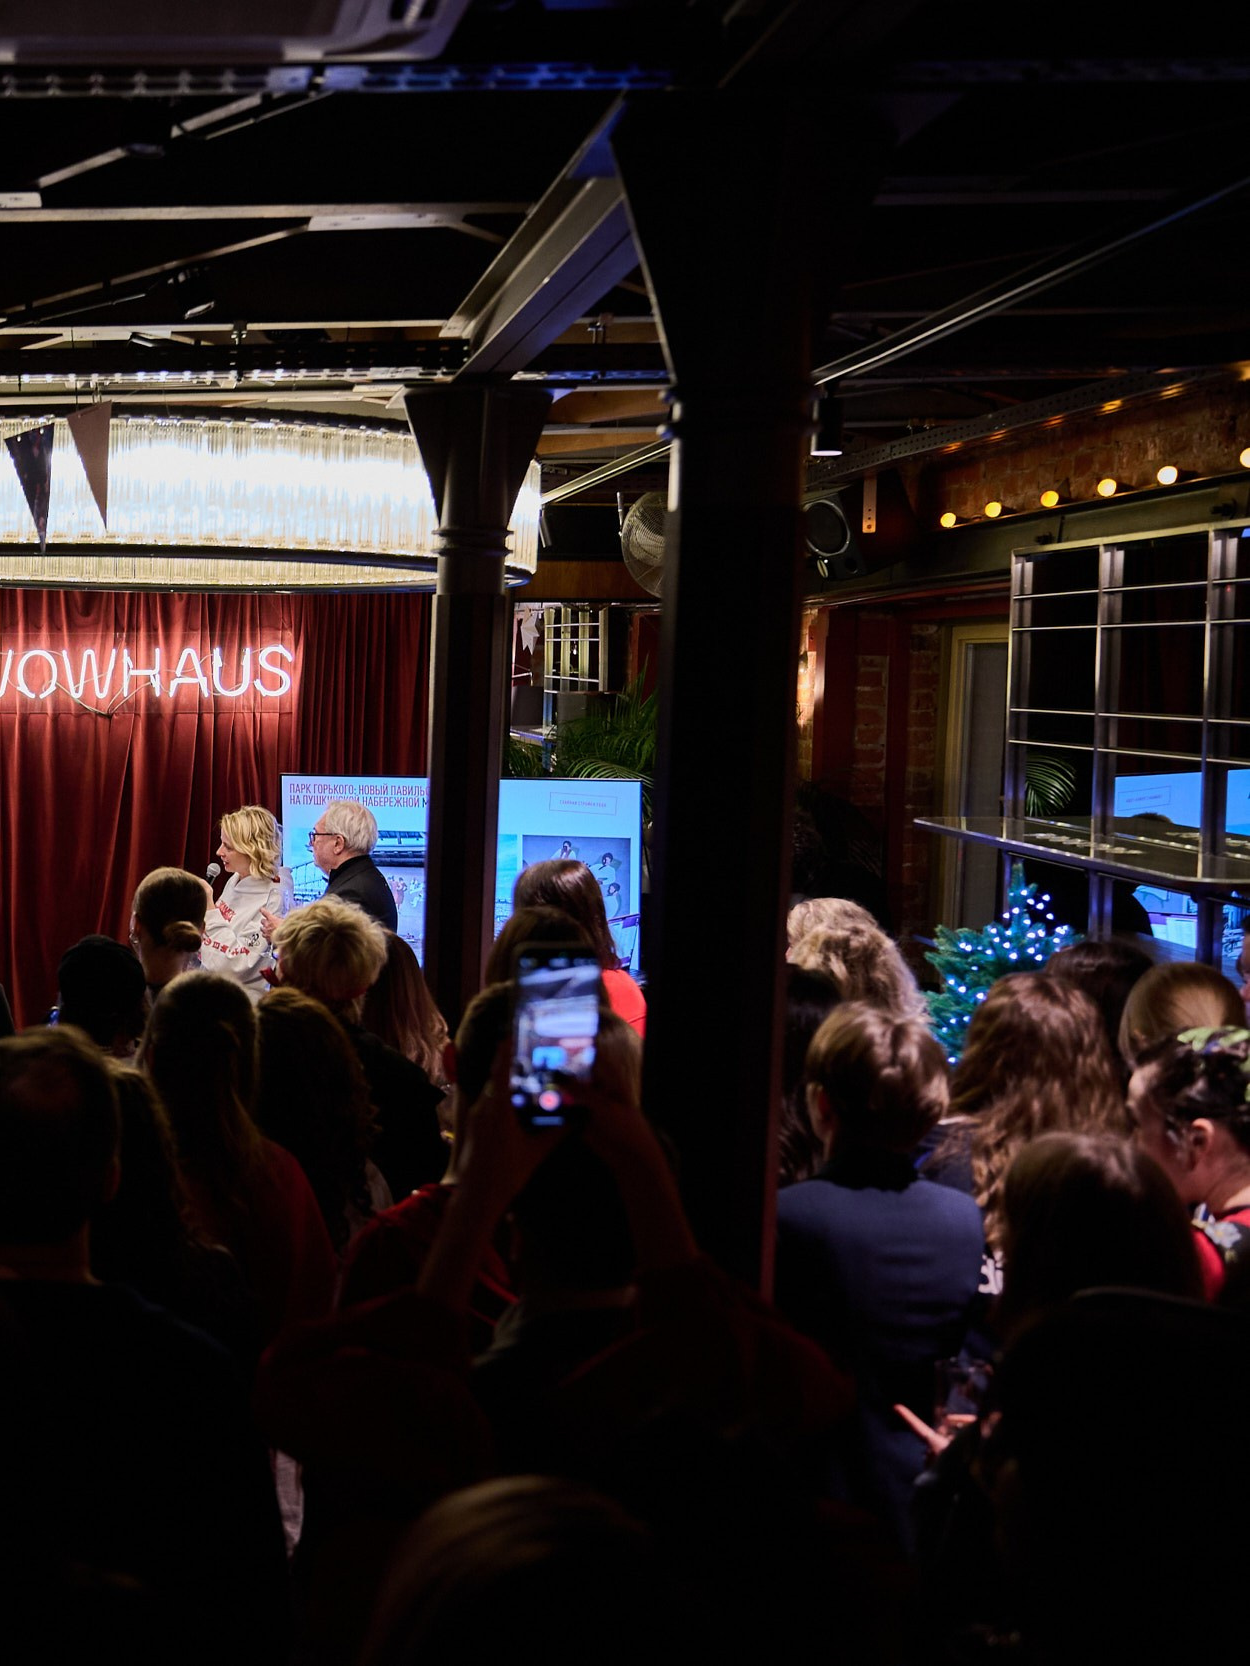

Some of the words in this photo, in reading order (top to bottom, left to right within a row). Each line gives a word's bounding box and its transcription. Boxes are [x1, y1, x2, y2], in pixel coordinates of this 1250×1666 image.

[289, 783, 311, 794] ПАРК
[313, 784, 356, 795] ГОРЬКОГО:
[358, 783, 388, 796] НОВЫЙ
[289, 794, 301, 805] НА
[362, 794, 420, 808] НАБЕРЕЖНОЙ
